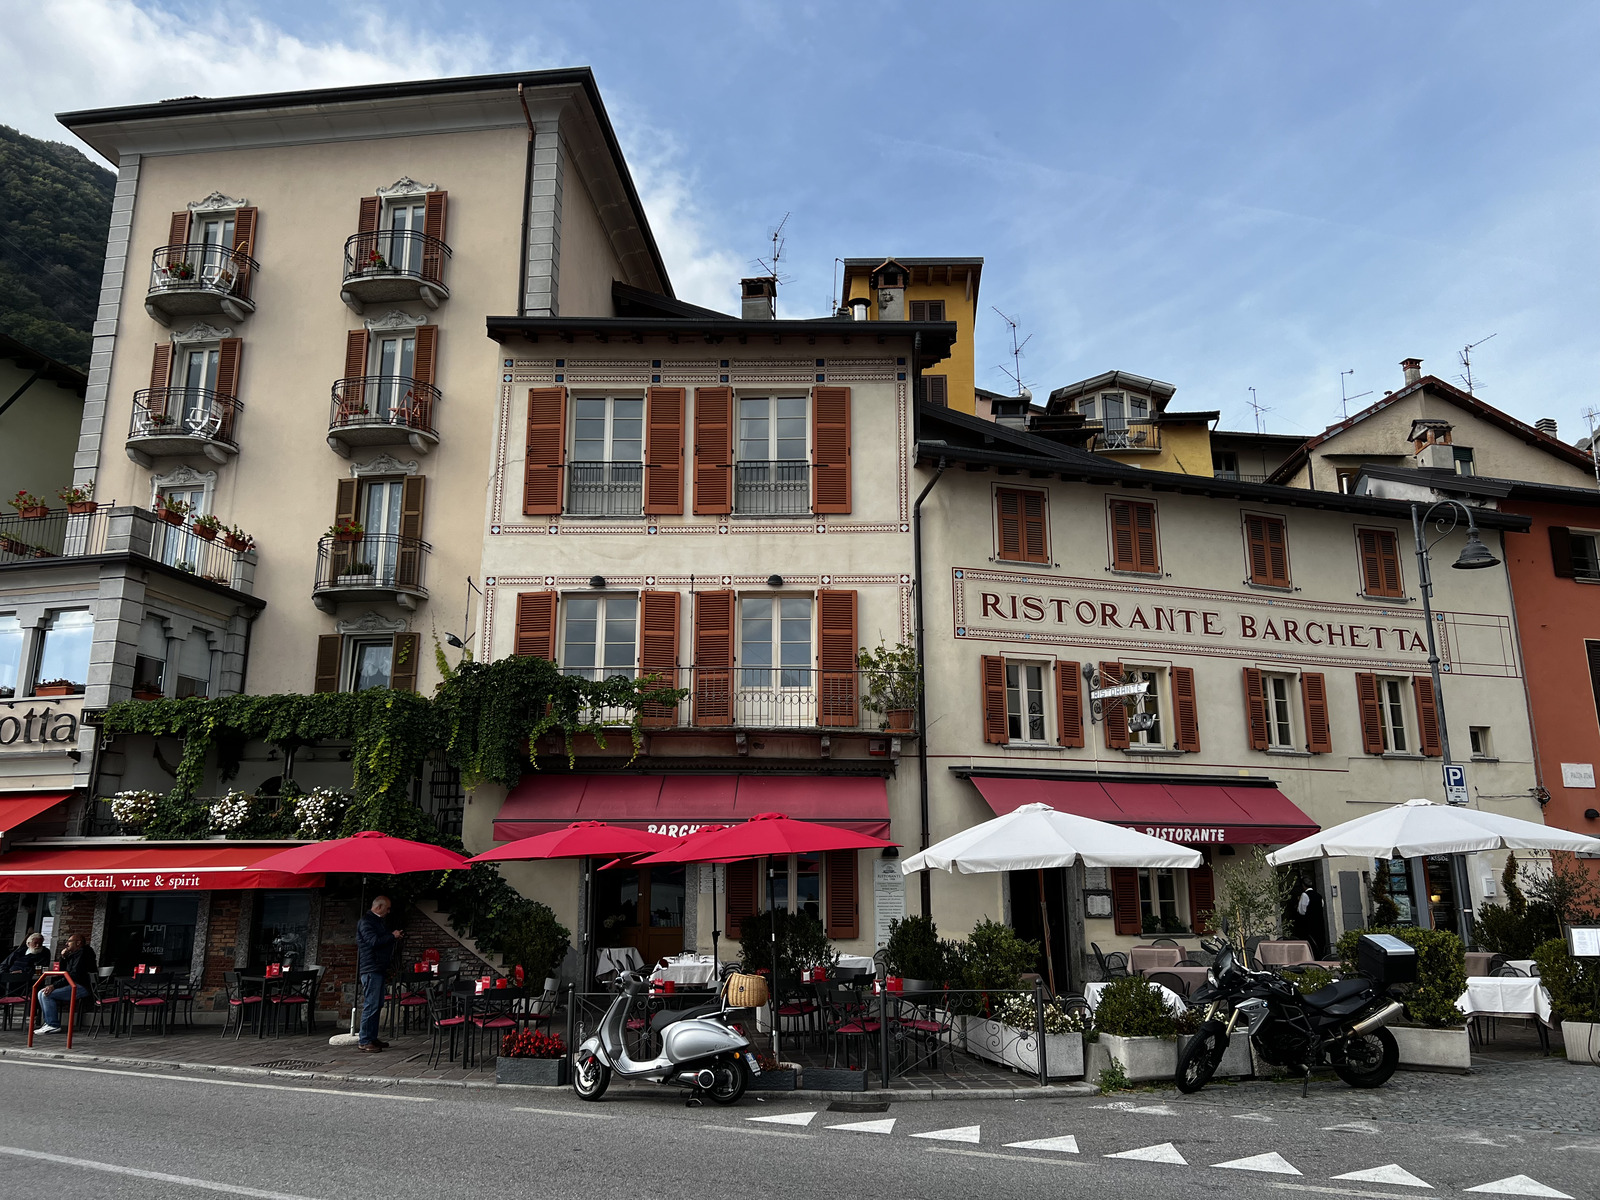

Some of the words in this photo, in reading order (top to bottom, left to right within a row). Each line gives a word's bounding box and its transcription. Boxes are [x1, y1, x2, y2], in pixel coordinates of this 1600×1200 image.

[980, 592, 1224, 635] RISTORANTE
[1240, 615, 1428, 652] BARCHETTA
[1094, 684, 1142, 698] RISTORANTE
[1448, 768, 1461, 786] P
[1146, 828, 1225, 842] RISTORANTE
[63, 875, 117, 889] Cocktail,
[121, 875, 151, 887] wine
[154, 874, 165, 886] &
[168, 874, 200, 889] spirit
